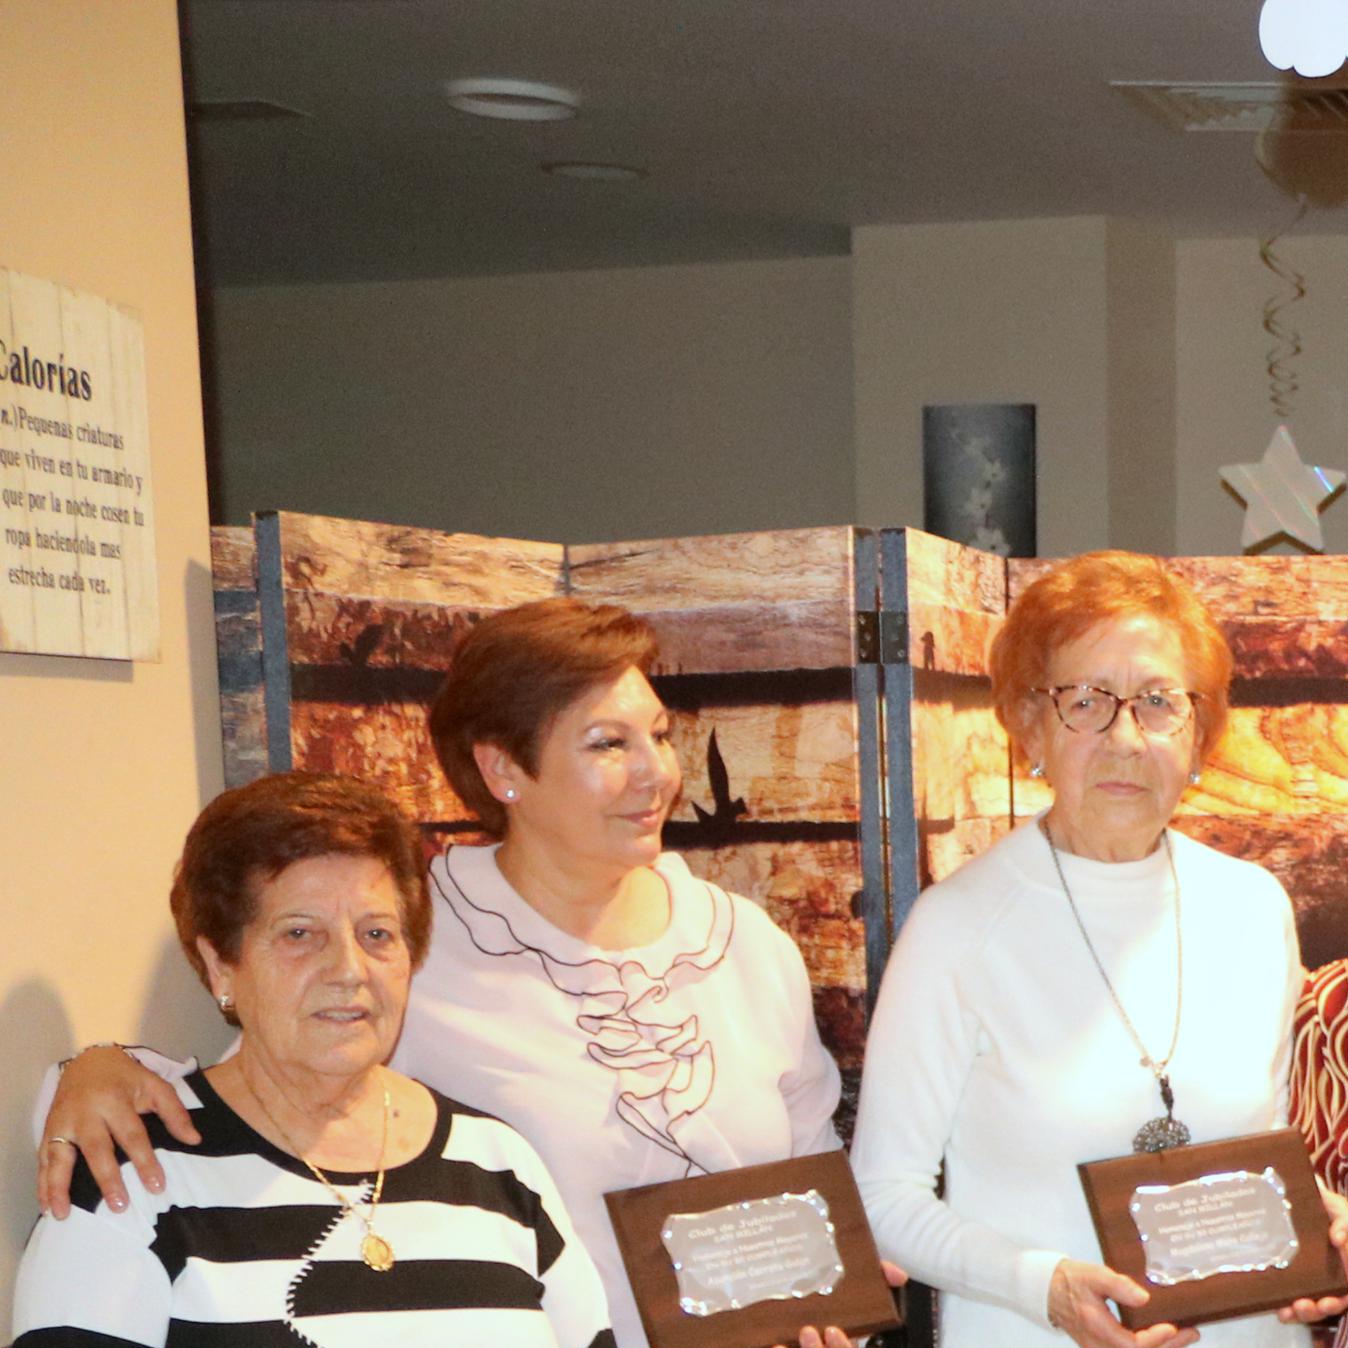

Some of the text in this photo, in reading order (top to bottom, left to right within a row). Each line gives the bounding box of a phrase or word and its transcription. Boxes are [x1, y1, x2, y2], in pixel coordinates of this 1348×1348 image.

[76, 423, 124, 450] criaturas
[0, 448, 143, 497] que viven en tu armario y
[2, 488, 144, 527] que por la noche cosen tu
[5, 528, 31, 550] ropa
[8, 565, 55, 589] estrecha
[59, 570, 85, 592] cada
